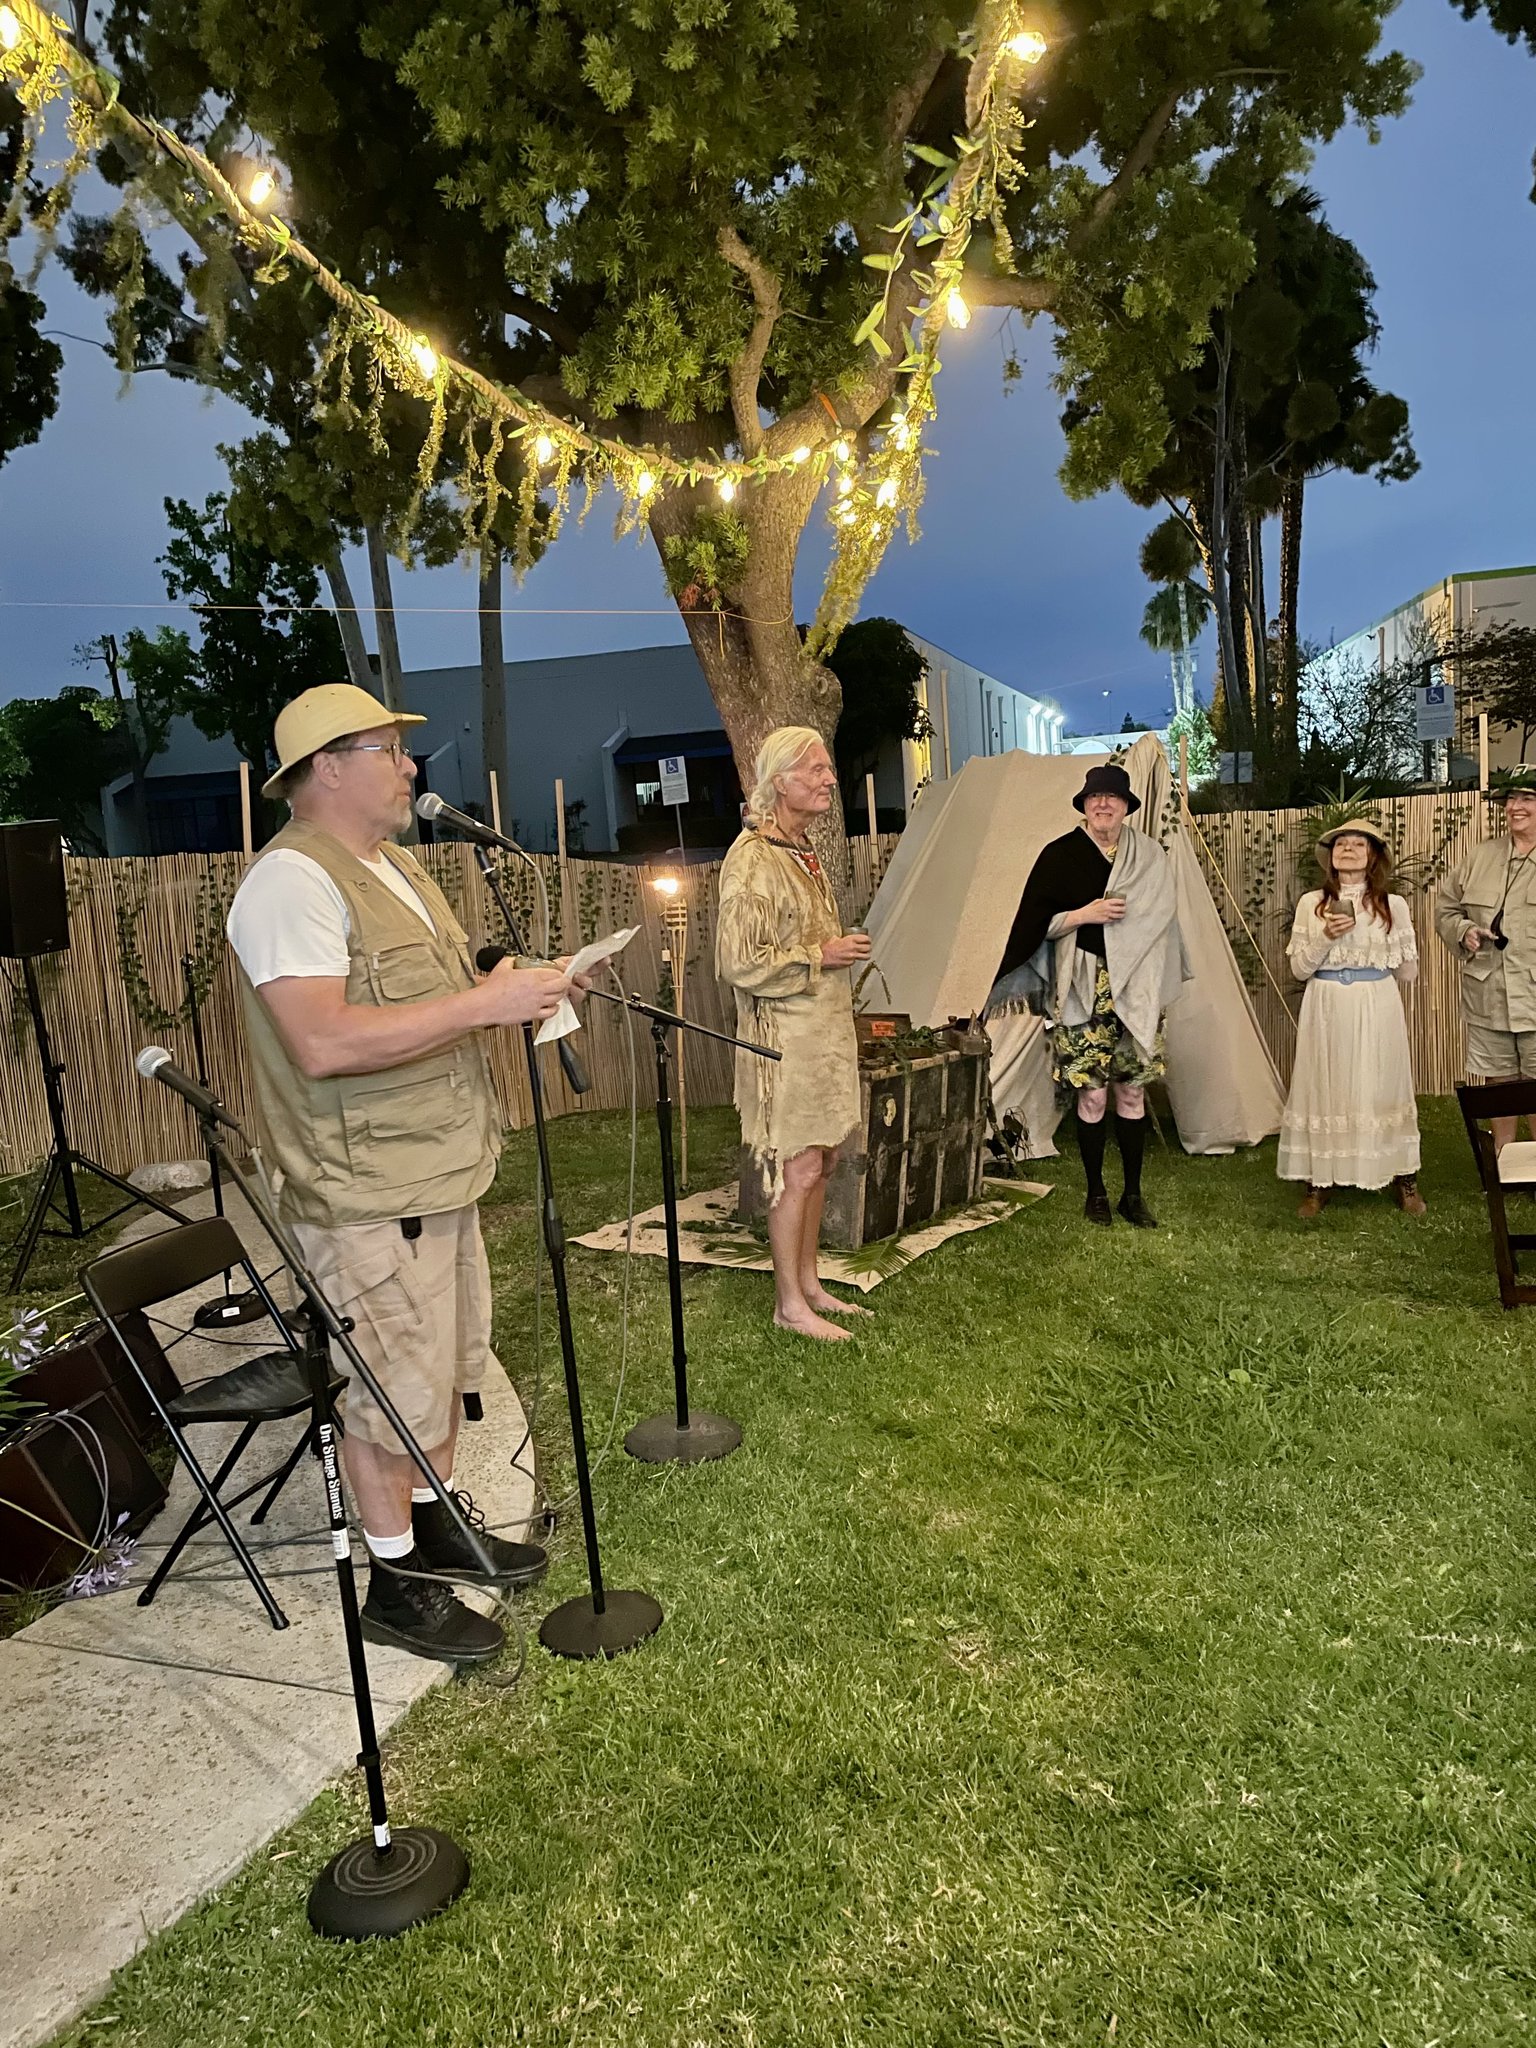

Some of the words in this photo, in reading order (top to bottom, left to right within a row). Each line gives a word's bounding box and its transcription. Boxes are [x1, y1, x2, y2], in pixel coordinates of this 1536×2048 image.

[320, 1423, 332, 1444] On
[323, 1444, 336, 1479] Stage
[328, 1479, 343, 1520] Stands
